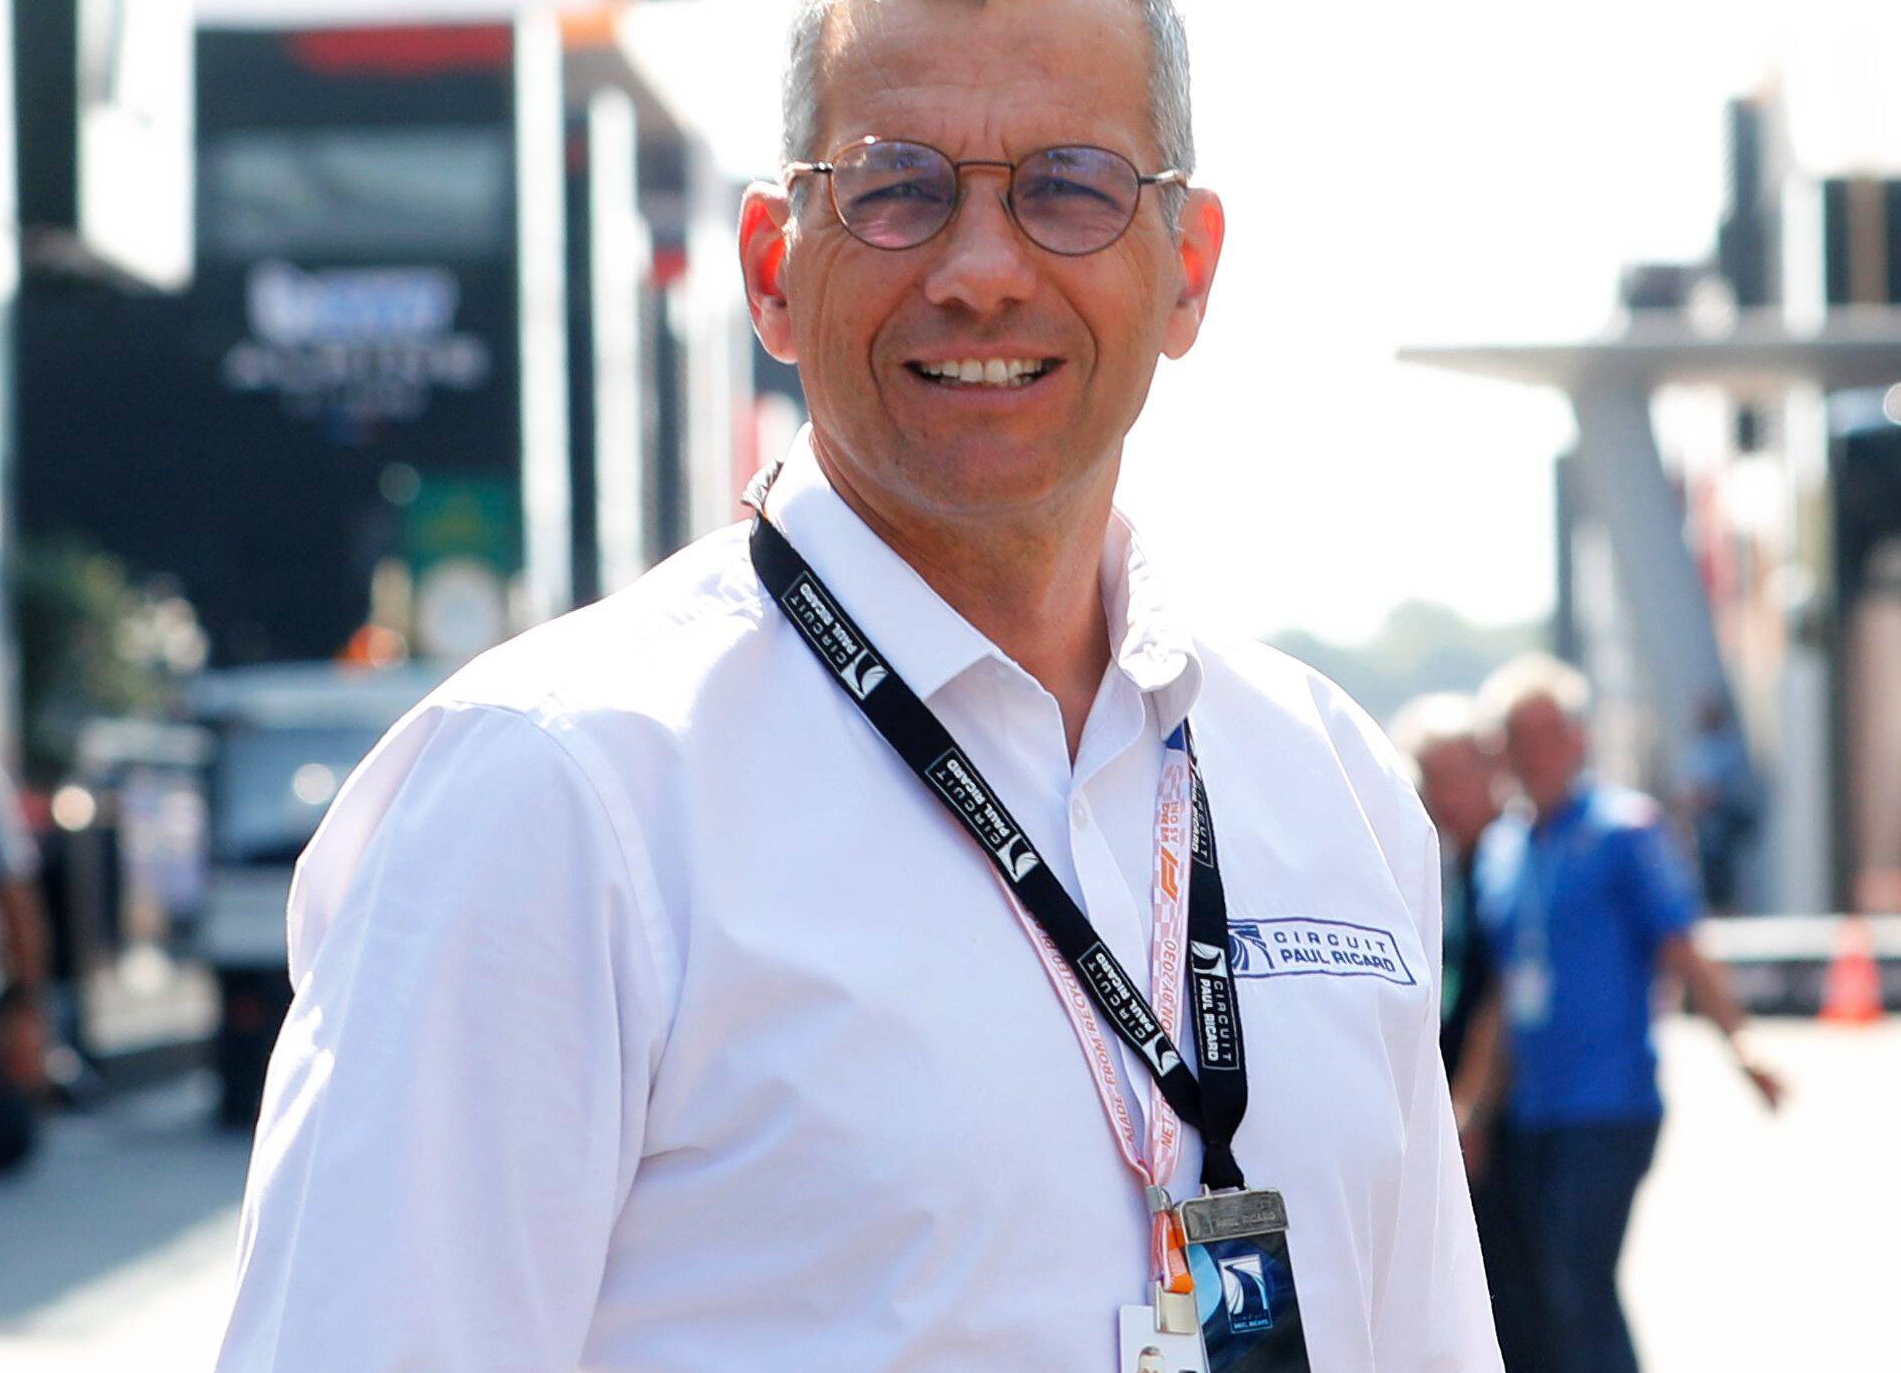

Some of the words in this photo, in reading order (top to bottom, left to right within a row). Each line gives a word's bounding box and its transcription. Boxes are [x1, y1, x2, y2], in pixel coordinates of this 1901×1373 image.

[799, 583, 835, 627] RICARD
[790, 595, 847, 665] CIRCUIT
[832, 622, 858, 655] PAUL
[946, 759, 986, 805] RICARD
[935, 769, 1002, 845] CIRCUIT
[983, 804, 1010, 837] PAUL
[1162, 940, 1177, 981] 2030
[1273, 931, 1385, 953] CIRCUIT
[1281, 948, 1330, 965] PAUL
[1331, 950, 1396, 973] RICARD
[1095, 952, 1132, 1000] RICARD
[1162, 981, 1174, 1005] BY
[1200, 978, 1214, 1011] PAUL
[1088, 962, 1147, 1039] CIRCUIT
[1128, 999, 1155, 1032] PAUL
[1214, 980, 1232, 1062] CIRCUIT
[1203, 1013, 1219, 1062] RICARD
[1092, 1037, 1116, 1086] FROM
[1161, 1116, 1175, 1148] NET
